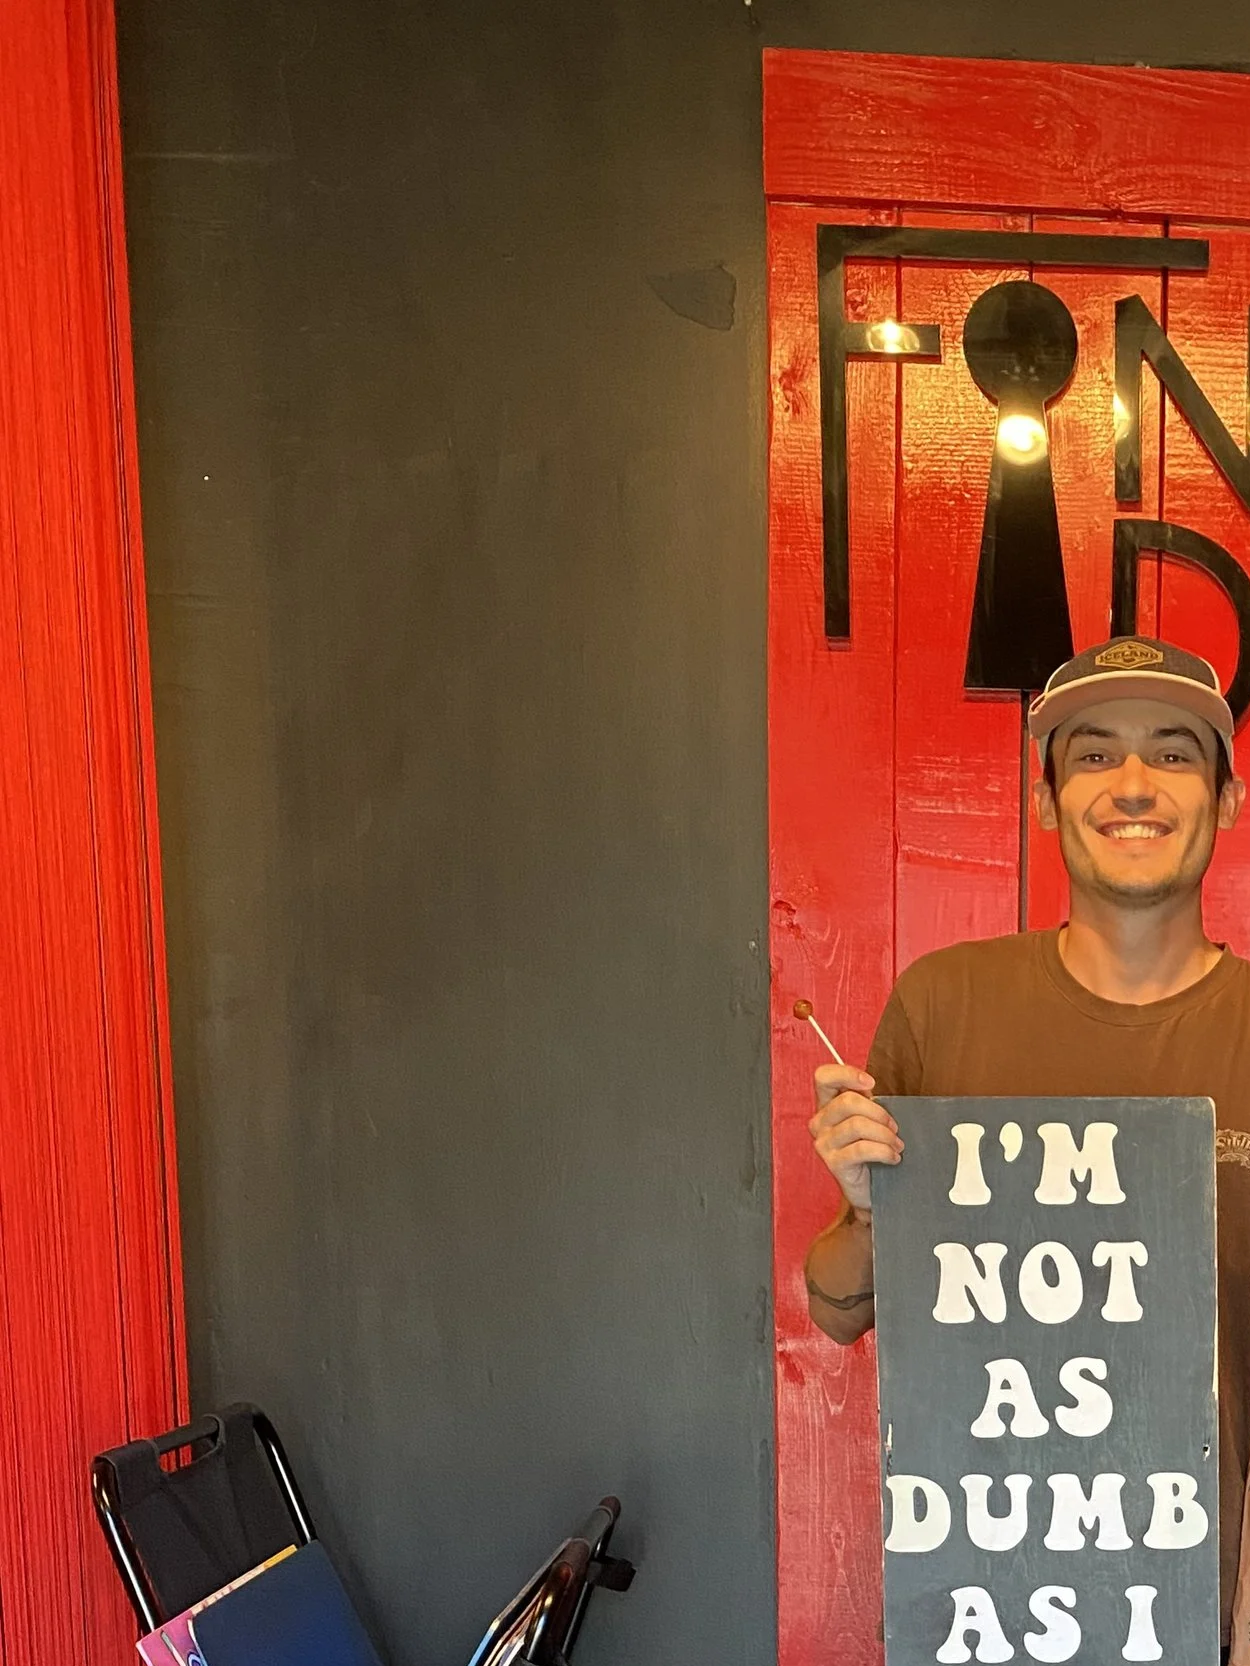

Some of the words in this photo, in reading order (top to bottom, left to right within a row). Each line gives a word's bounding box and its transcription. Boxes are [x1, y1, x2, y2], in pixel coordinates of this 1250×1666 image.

[1099, 650, 1159, 663] ICELAND
[948, 1121, 1127, 1206] I'M
[932, 1240, 1149, 1325] NOT
[970, 1356, 1114, 1439] AS
[884, 1472, 1209, 1553] DUMB
[935, 1585, 1082, 1664] AS
[1121, 1584, 1164, 1662] I
